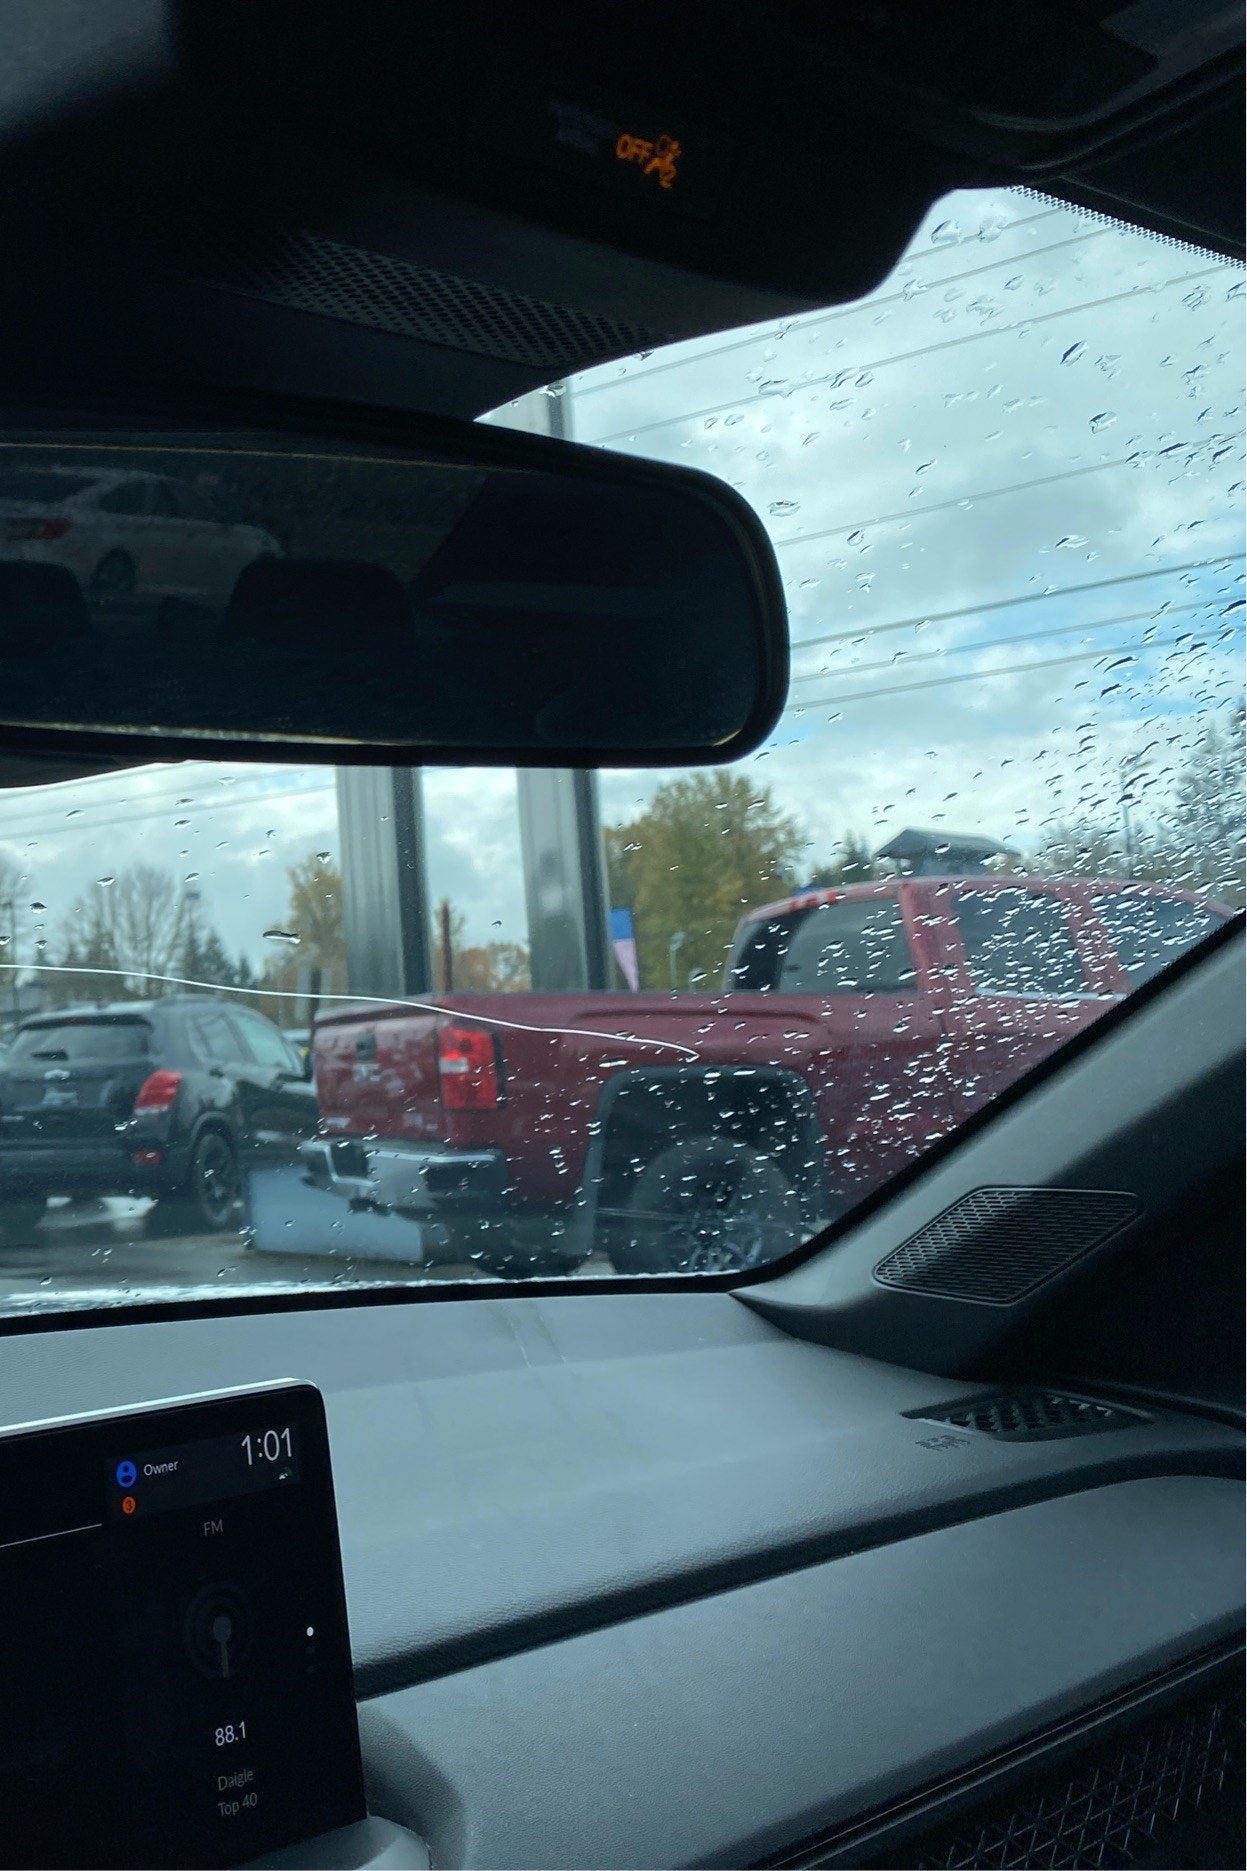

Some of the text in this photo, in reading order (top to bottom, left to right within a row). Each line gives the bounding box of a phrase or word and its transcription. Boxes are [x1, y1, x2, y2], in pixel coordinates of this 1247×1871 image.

[616, 133, 652, 163] OFF
[241, 1427, 292, 1466] 1:01
[143, 1460, 179, 1476] Owner
[203, 1519, 224, 1537] FM
[215, 1721, 246, 1746] 88.1
[217, 1769, 254, 1791] Daigle
[217, 1792, 258, 1816] Top 40
